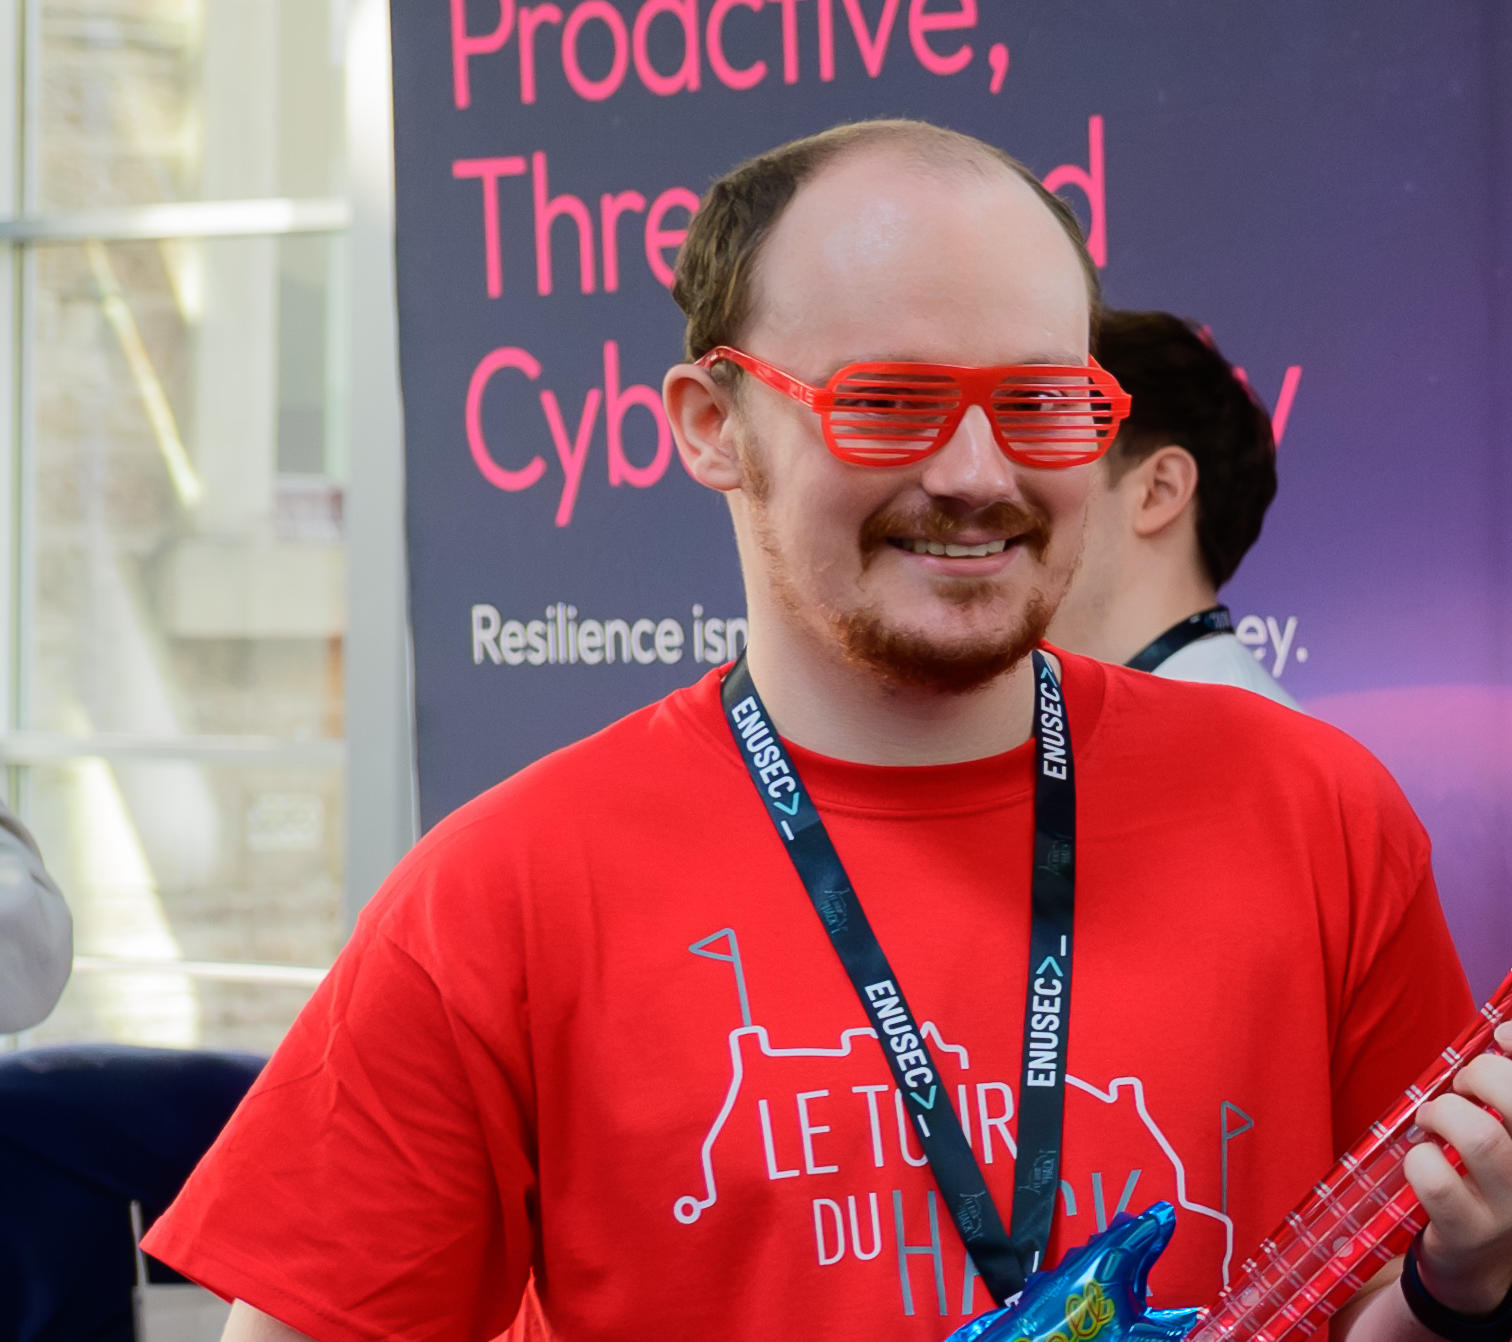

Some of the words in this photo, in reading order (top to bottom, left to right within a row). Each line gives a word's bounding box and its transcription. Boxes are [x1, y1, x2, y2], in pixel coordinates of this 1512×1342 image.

[452, 151, 700, 299] Thre
[465, 340, 673, 528] Cyb
[471, 602, 684, 665] Resilience
[692, 603, 749, 664] isn
[1235, 613, 1308, 679] ey.
[758, 1089, 839, 1181] LE
[812, 1192, 882, 1266] DU
